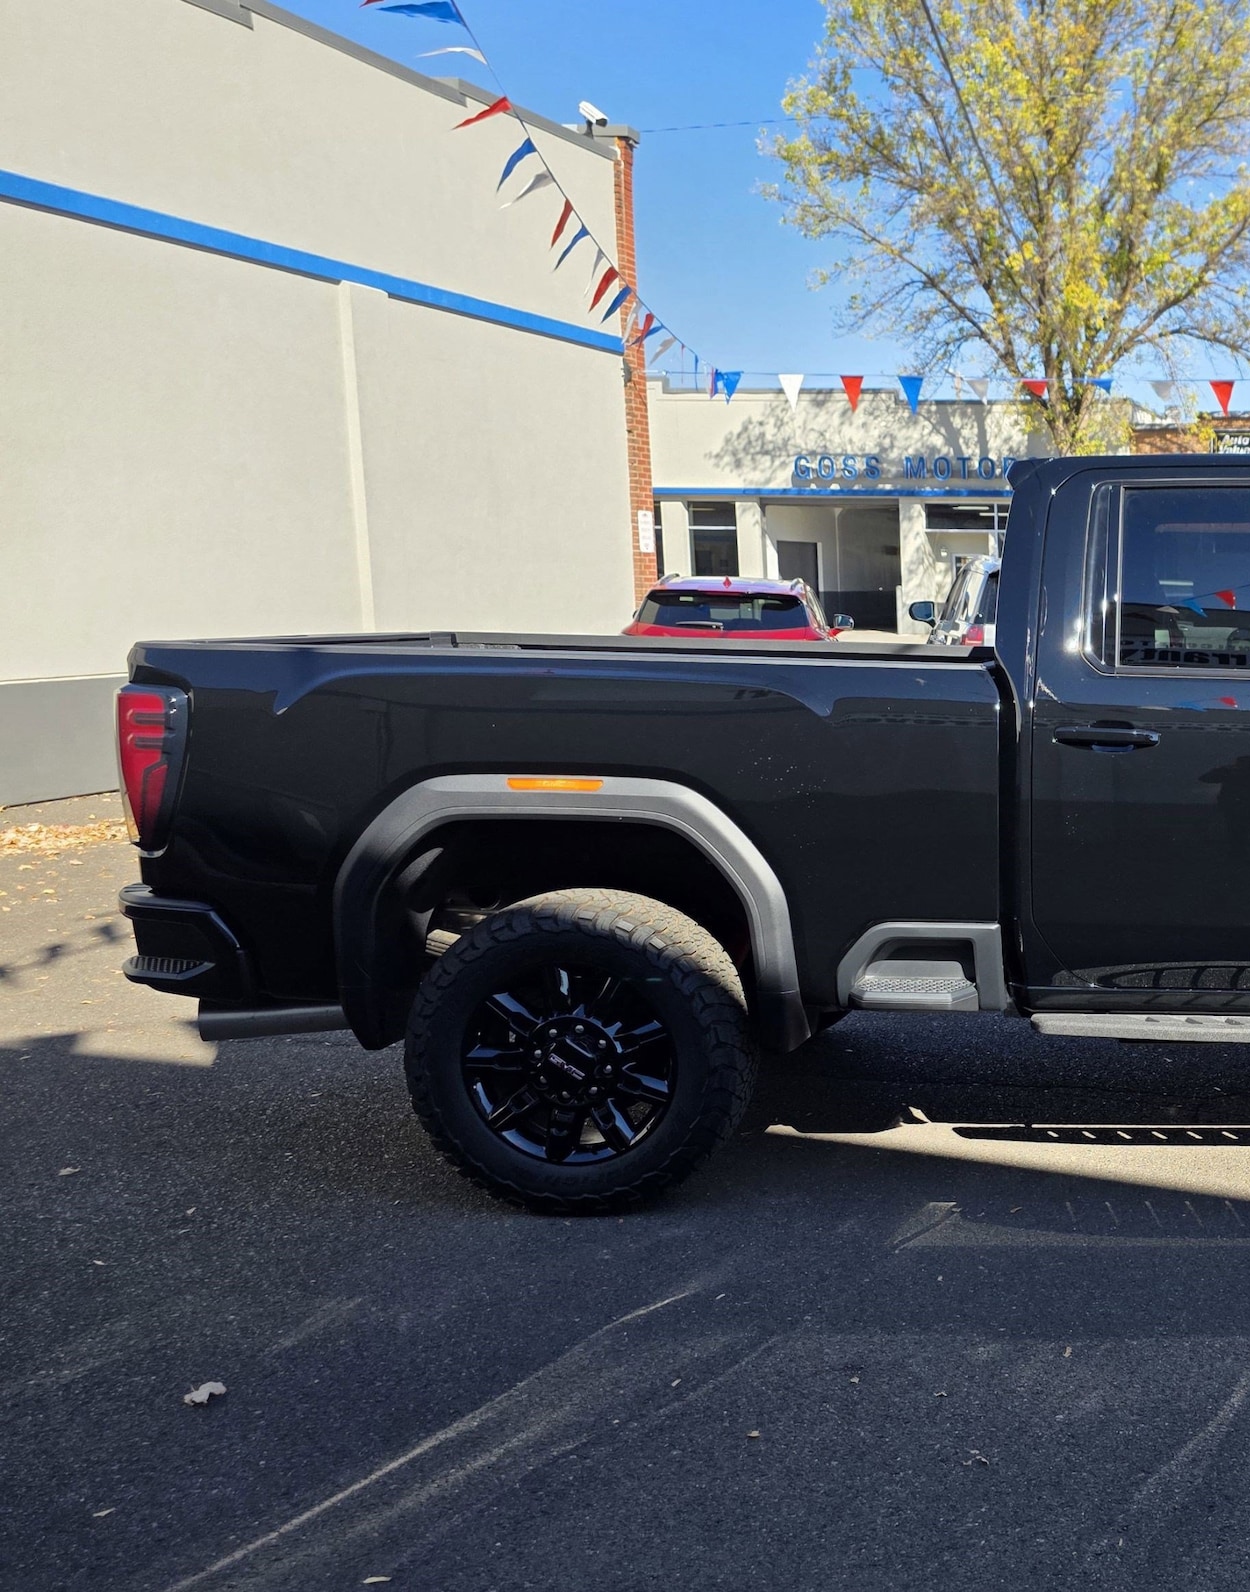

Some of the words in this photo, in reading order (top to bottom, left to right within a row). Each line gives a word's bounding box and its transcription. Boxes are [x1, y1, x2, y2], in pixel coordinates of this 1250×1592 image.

[1221, 434, 1250, 446] Auto
[794, 455, 881, 481] GOSS
[548, 1052, 586, 1080] GMC
